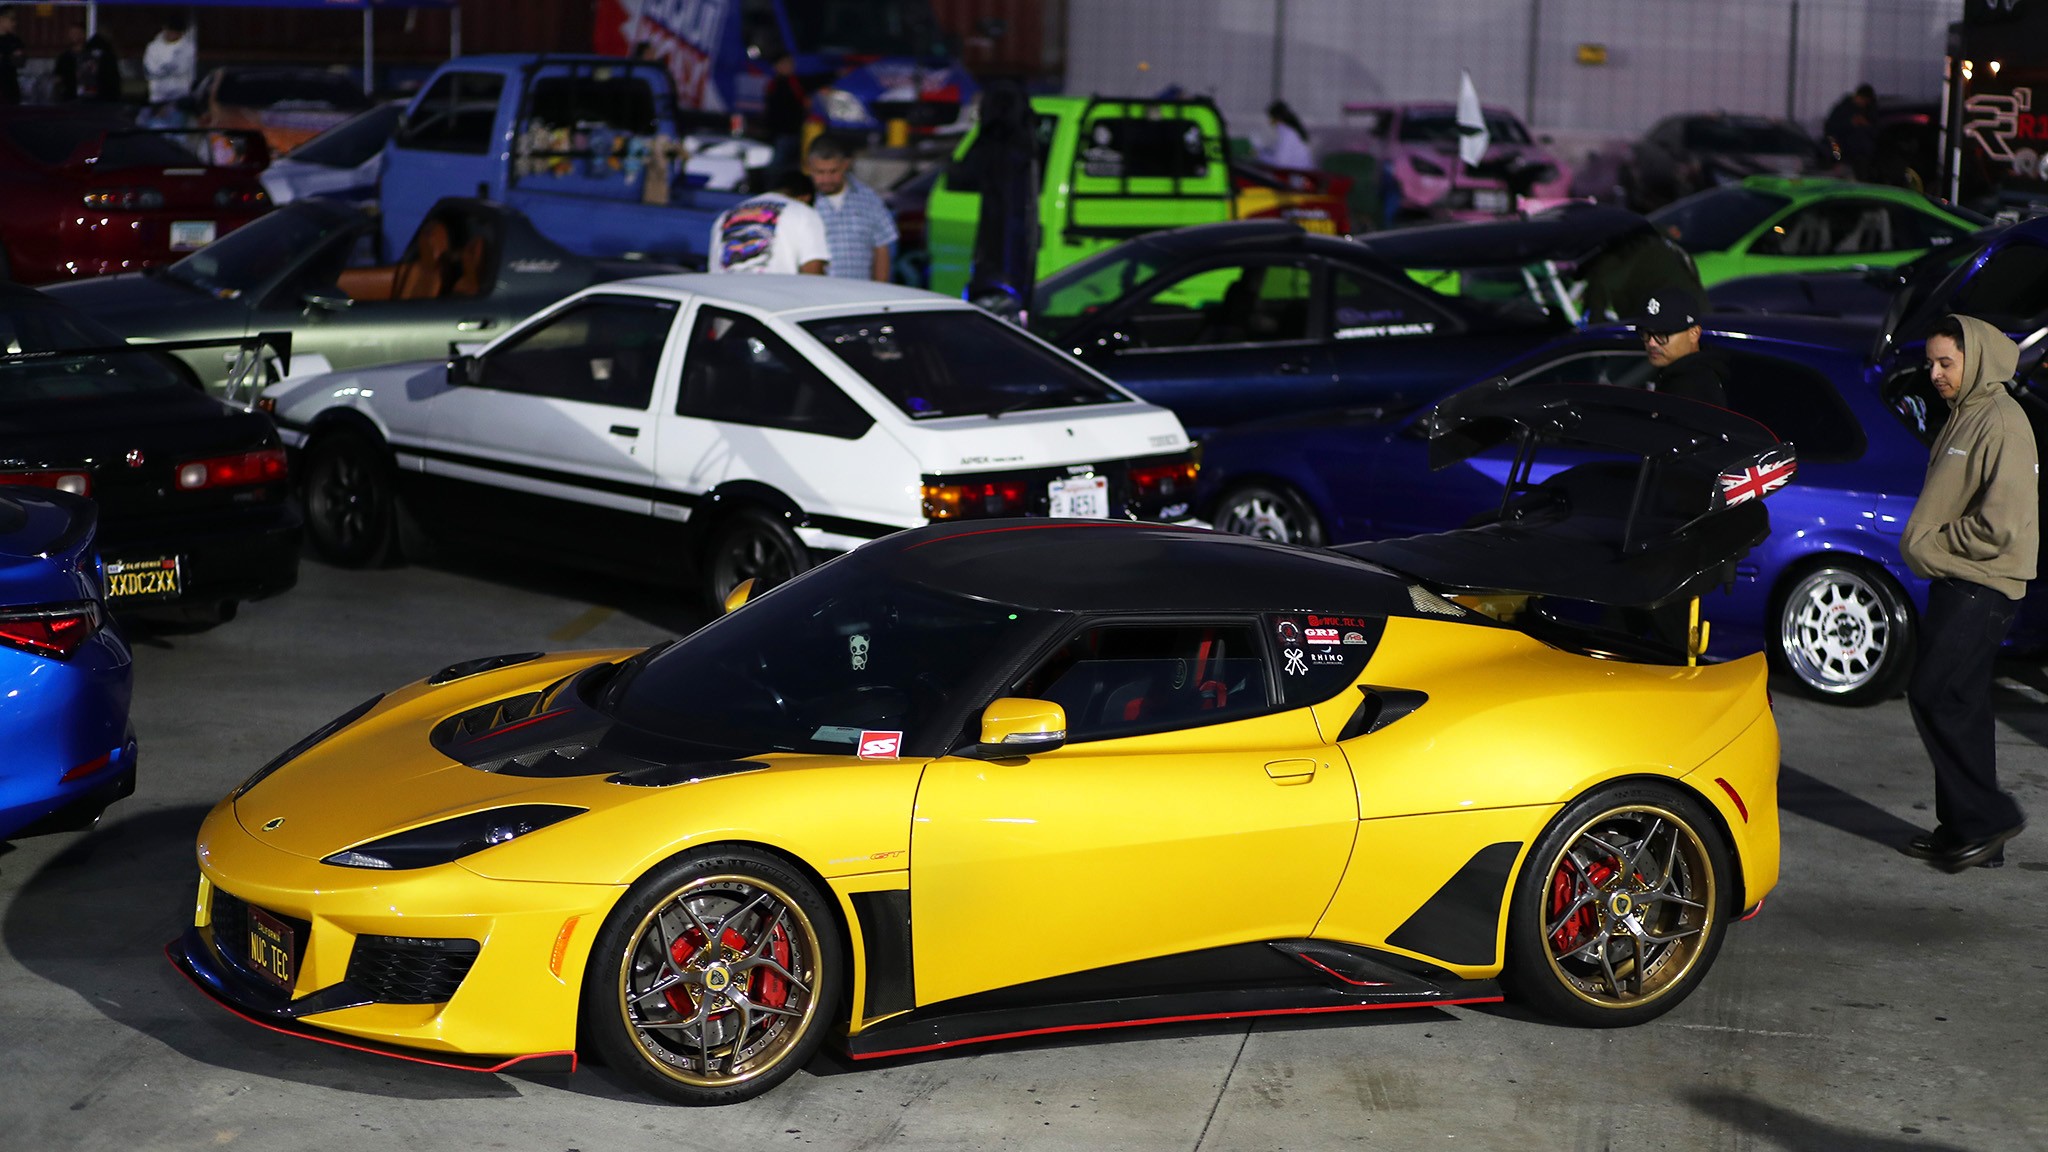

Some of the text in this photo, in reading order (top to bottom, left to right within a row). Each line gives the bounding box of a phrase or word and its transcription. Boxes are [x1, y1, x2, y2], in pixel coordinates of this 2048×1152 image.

[109, 570, 176, 596] XXDC2XX
[860, 738, 898, 756] SS
[258, 923, 280, 942] CALIFORNIA
[251, 932, 288, 981] NUC TEC
